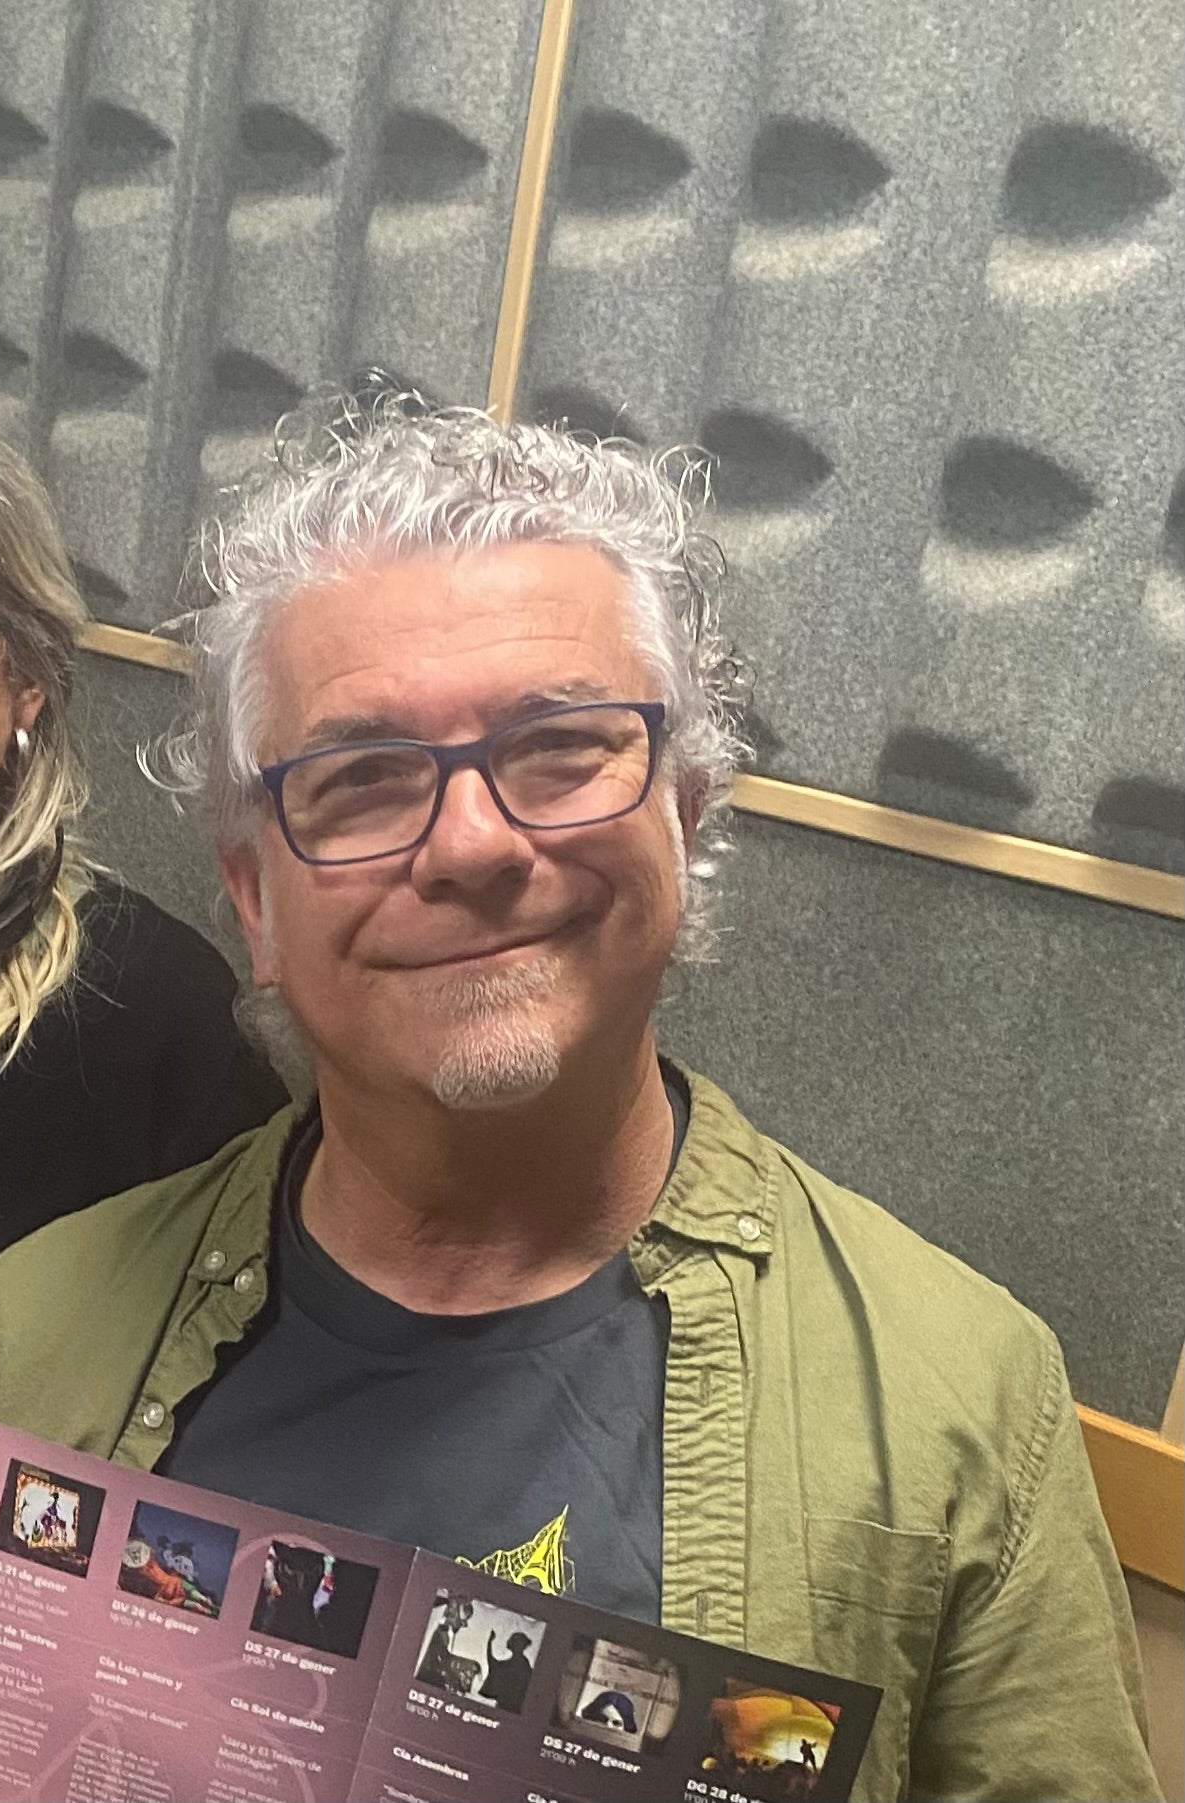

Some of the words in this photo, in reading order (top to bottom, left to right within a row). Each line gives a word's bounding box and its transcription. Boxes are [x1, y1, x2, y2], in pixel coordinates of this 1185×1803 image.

[19, 1568, 34, 1582] de
[34, 1575, 68, 1595] gener
[5, 1623, 18, 1636] de
[148, 1609, 164, 1624] de
[165, 1616, 200, 1637] gener
[245, 1639, 264, 1655] DS
[264, 1645, 280, 1660] 27
[282, 1650, 299, 1665] de
[299, 1656, 336, 1678] gener
[99, 1654, 117, 1669] Cia
[175, 1679, 183, 1692] y
[231, 1696, 251, 1711] Cia
[251, 1702, 271, 1717] Sol
[272, 1708, 288, 1722] de
[409, 1688, 428, 1704] DS
[428, 1695, 444, 1710] 27
[445, 1701, 463, 1717] de
[462, 1709, 500, 1731] gener
[309, 1759, 323, 1773] de
[393, 1745, 413, 1761] Cia
[544, 1734, 564, 1750] DS
[565, 1740, 582, 1756] 27
[583, 1746, 601, 1762] de
[602, 1754, 641, 1776] gener
[687, 1779, 708, 1795] DG
[710, 1786, 728, 1800] 28
